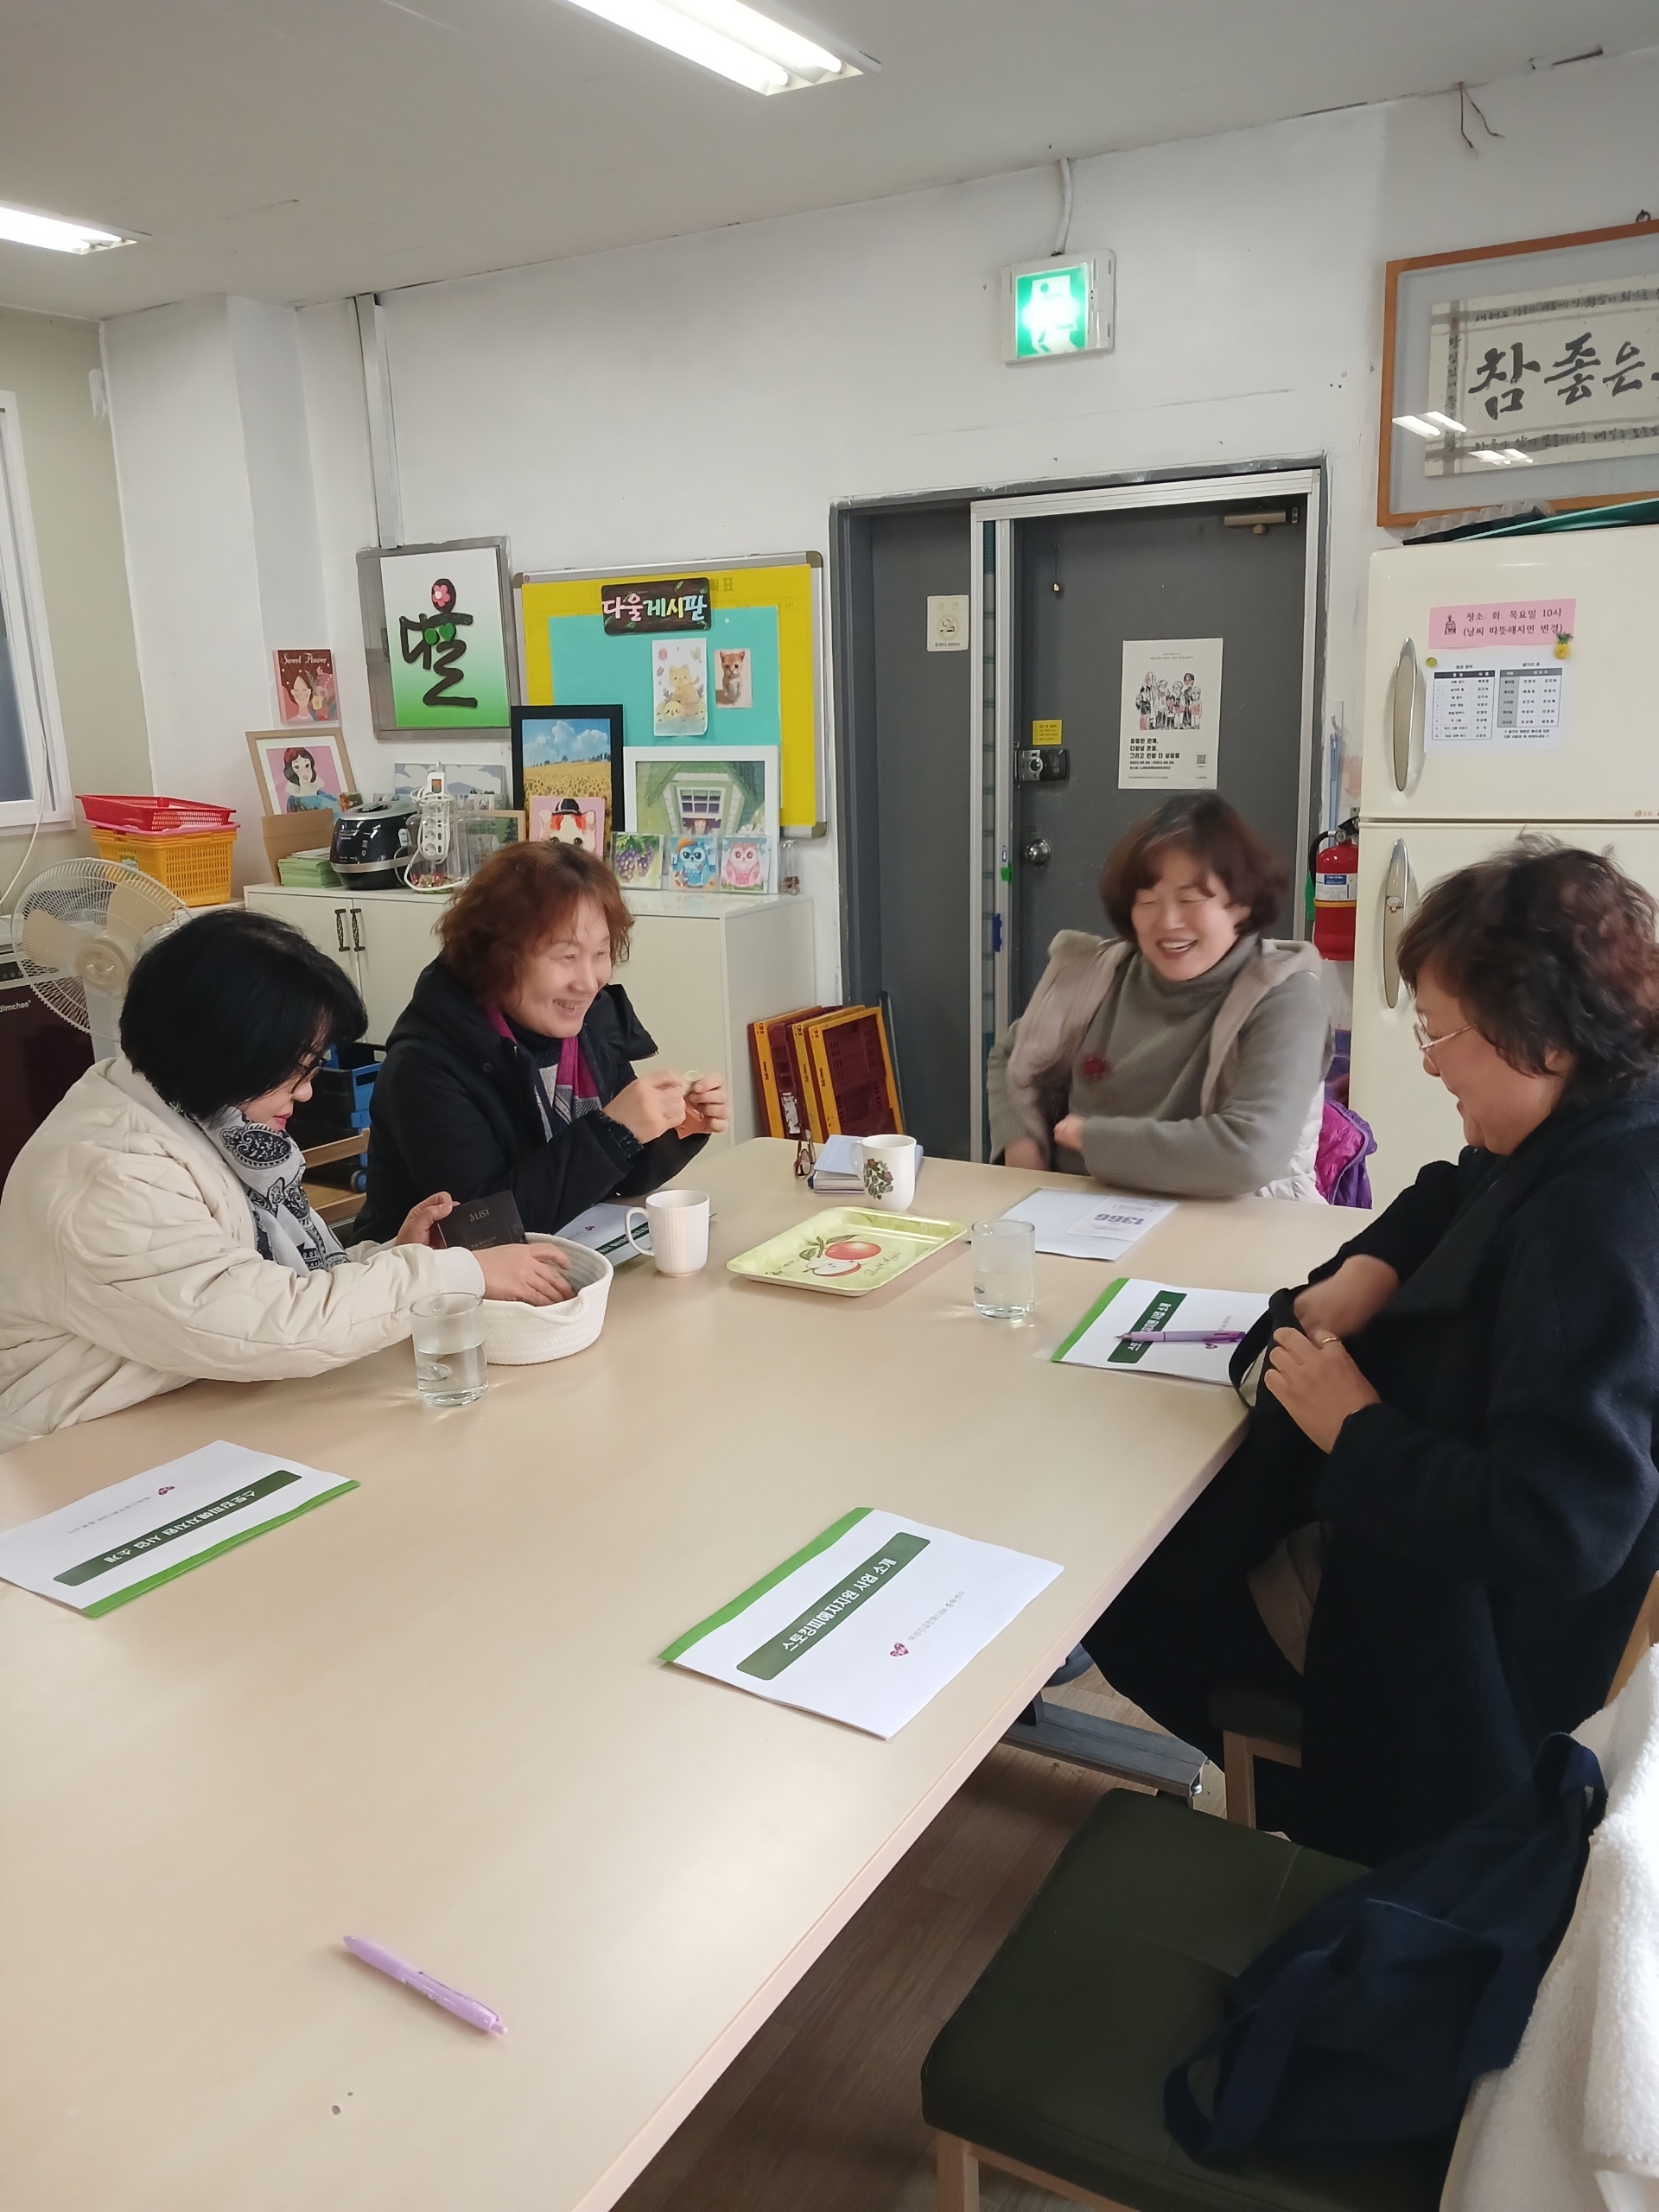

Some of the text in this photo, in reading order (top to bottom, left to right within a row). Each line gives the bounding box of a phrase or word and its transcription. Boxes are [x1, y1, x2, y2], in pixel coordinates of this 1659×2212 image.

[1510, 609, 1536, 620] 목요일
[1542, 607, 1562, 618] 10시
[1463, 626, 1484, 637] (날씨
[1489, 624, 1535, 635] 따뜻해지면
[280, 652, 327, 665] Sweet Flower
[1094, 1213, 1145, 1225] 1366
[103, 1489, 257, 1565] 스토킹피해자지원 사업 소개
[781, 1557, 898, 1654] 스토킹피해자지원 사업 소개
